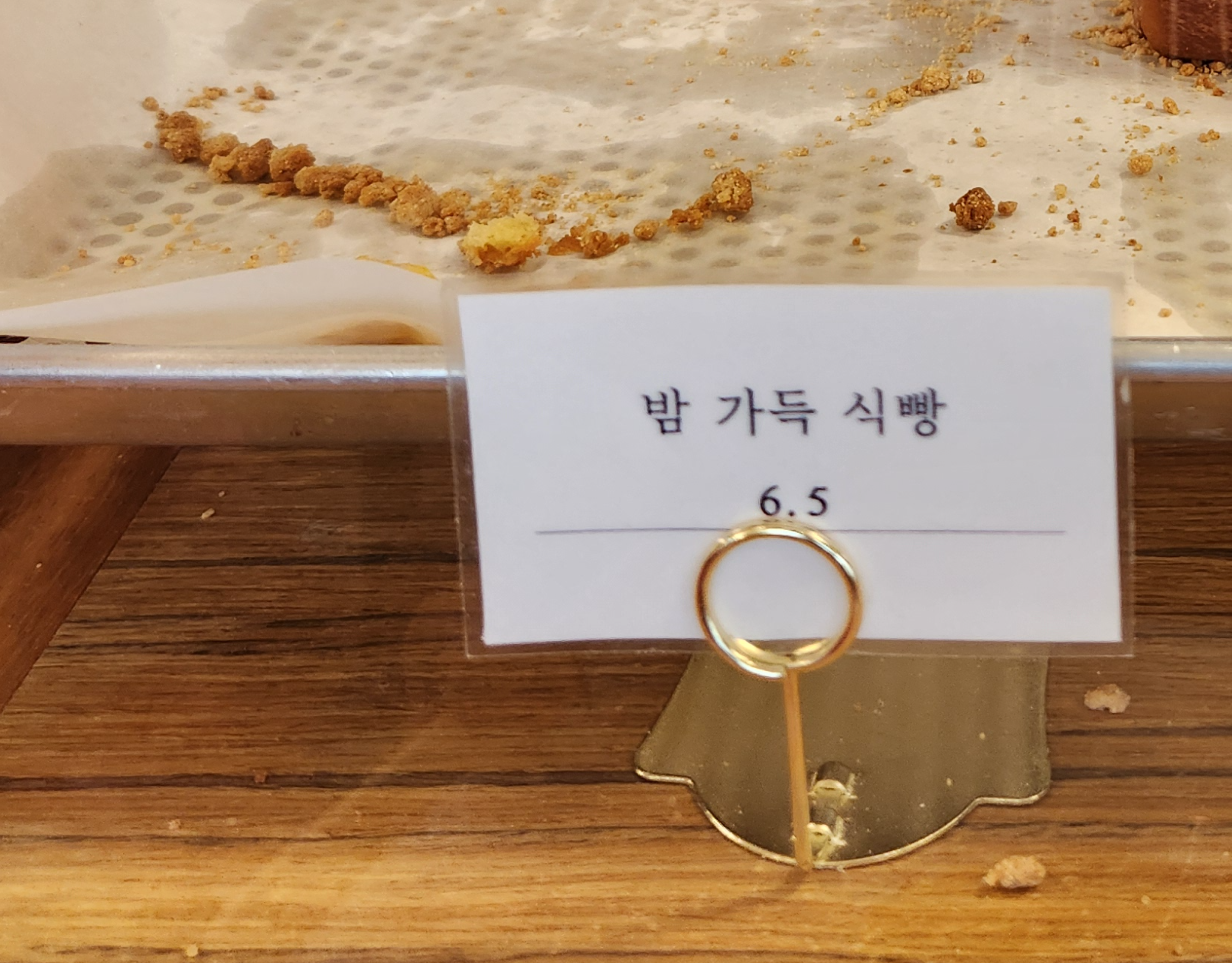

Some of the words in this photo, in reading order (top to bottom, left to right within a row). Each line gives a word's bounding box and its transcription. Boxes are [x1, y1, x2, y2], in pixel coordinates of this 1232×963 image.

[642, 387, 691, 436] 밤
[717, 387, 817, 437] 가득
[844, 387, 947, 438] 식빵
[758, 484, 829, 517] 6.5
